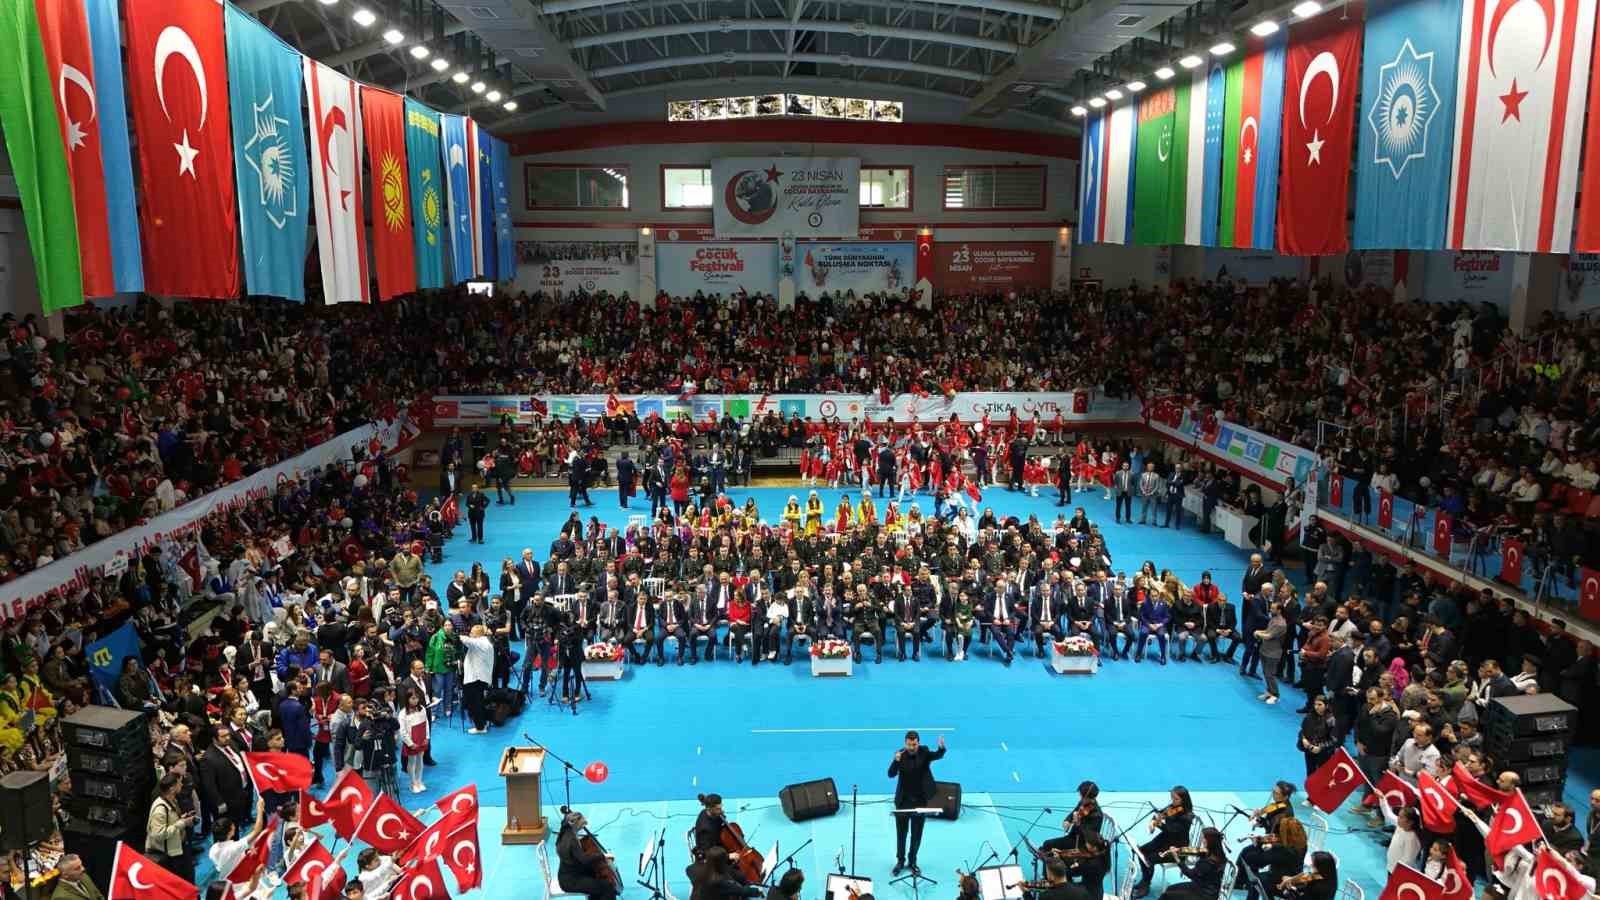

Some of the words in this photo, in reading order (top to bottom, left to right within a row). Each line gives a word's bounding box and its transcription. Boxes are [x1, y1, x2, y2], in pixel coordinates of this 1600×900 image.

[791, 169, 804, 181] 23
[696, 247, 738, 260] Çocuk
[952, 250, 970, 264] 23
[689, 260, 744, 272] Festivali
[1453, 255, 1500, 272] Festivali
[543, 265, 561, 279] 23
[986, 401, 1013, 413] TİKA
[1037, 401, 1057, 413] YTB
